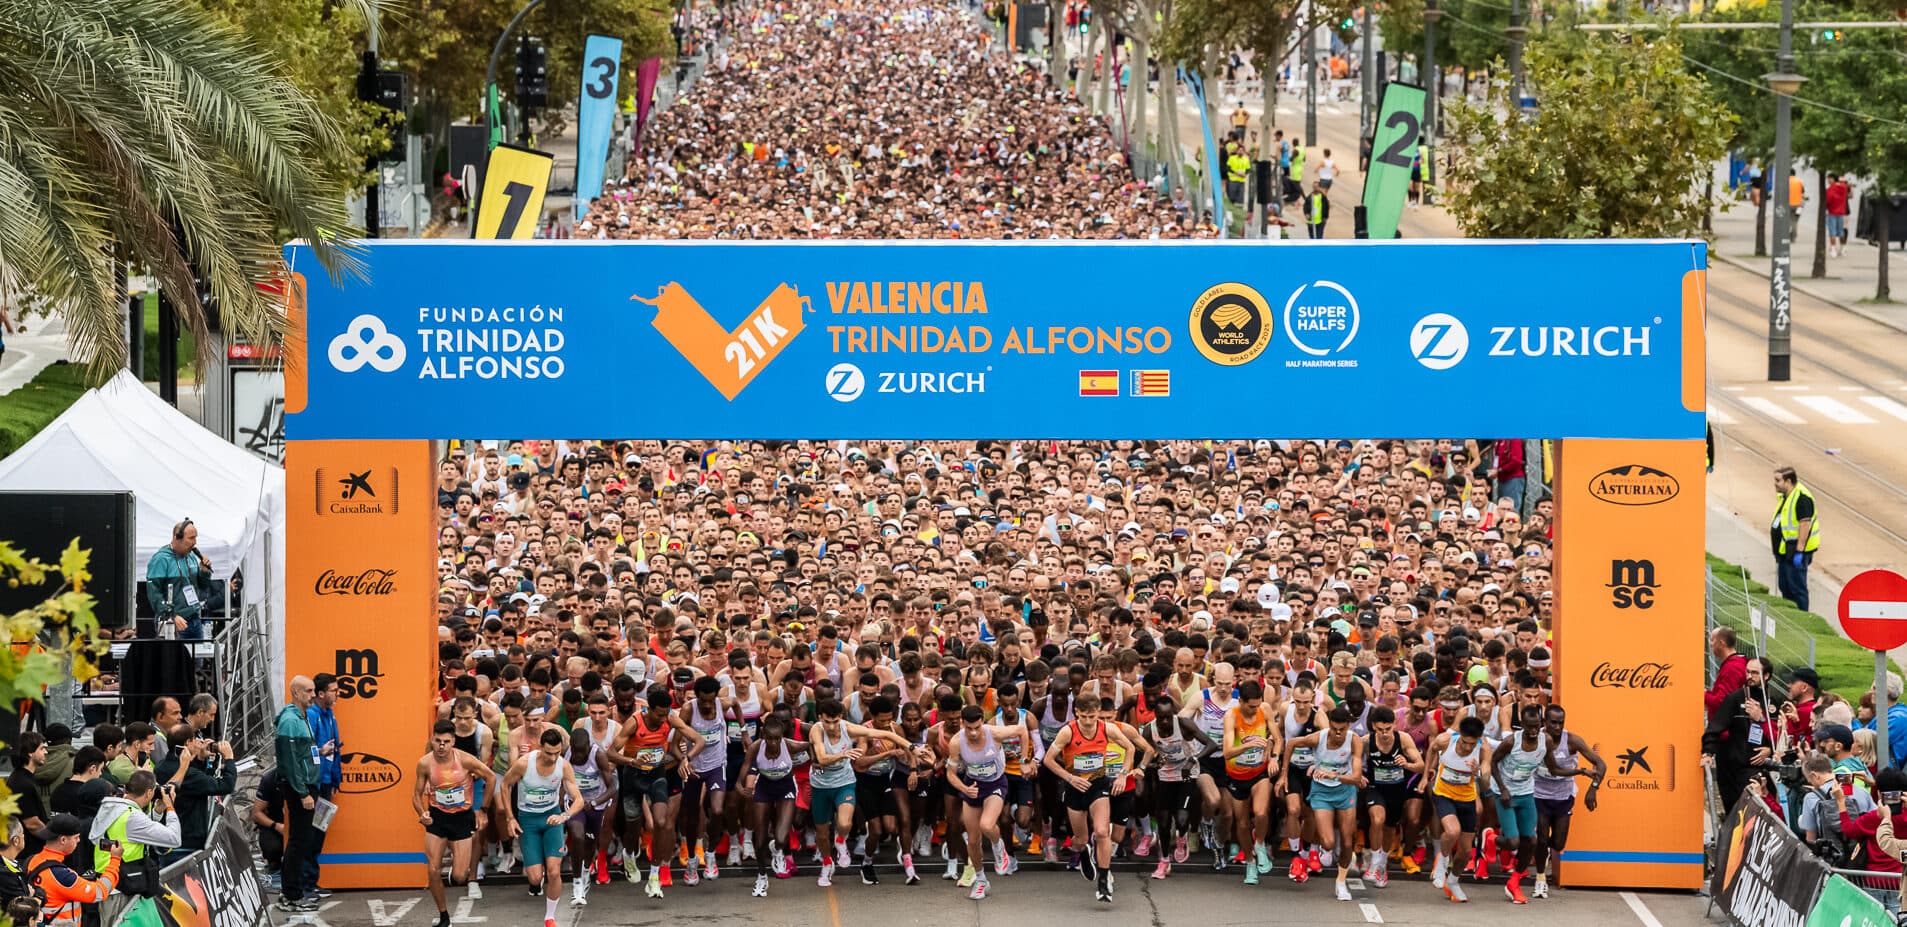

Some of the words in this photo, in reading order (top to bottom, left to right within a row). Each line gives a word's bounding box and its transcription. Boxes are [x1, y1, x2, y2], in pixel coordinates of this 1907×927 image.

[586, 57, 617, 99] 3
[1375, 111, 1419, 168] 2
[494, 181, 534, 240] 1
[825, 281, 989, 314] VALENCIA
[1193, 299, 1206, 318] GOLD
[1204, 287, 1225, 301] LABEL
[419, 304, 564, 323] FUNDACIÓN
[1297, 305, 1347, 318] SUPER
[1297, 319, 1346, 331] HALFS
[417, 328, 565, 353] TRINIDAD
[724, 305, 789, 380] 21K
[826, 325, 993, 354] TRINIDAD
[1001, 326, 1172, 355] ALFONSO
[1229, 354, 1250, 363] ROAD
[1248, 339, 1265, 356] RACE
[418, 355, 565, 380] ALFONSO
[1285, 360, 1302, 368] HALF
[1302, 360, 1337, 368] MARATHON
[1336, 360, 1358, 368] SERIES
[1597, 480, 1673, 495] ASTURIANA
[330, 502, 384, 514] CaixaBank
[339, 771, 395, 783] TURIANA
[1607, 779, 1660, 791] CaixaBank
